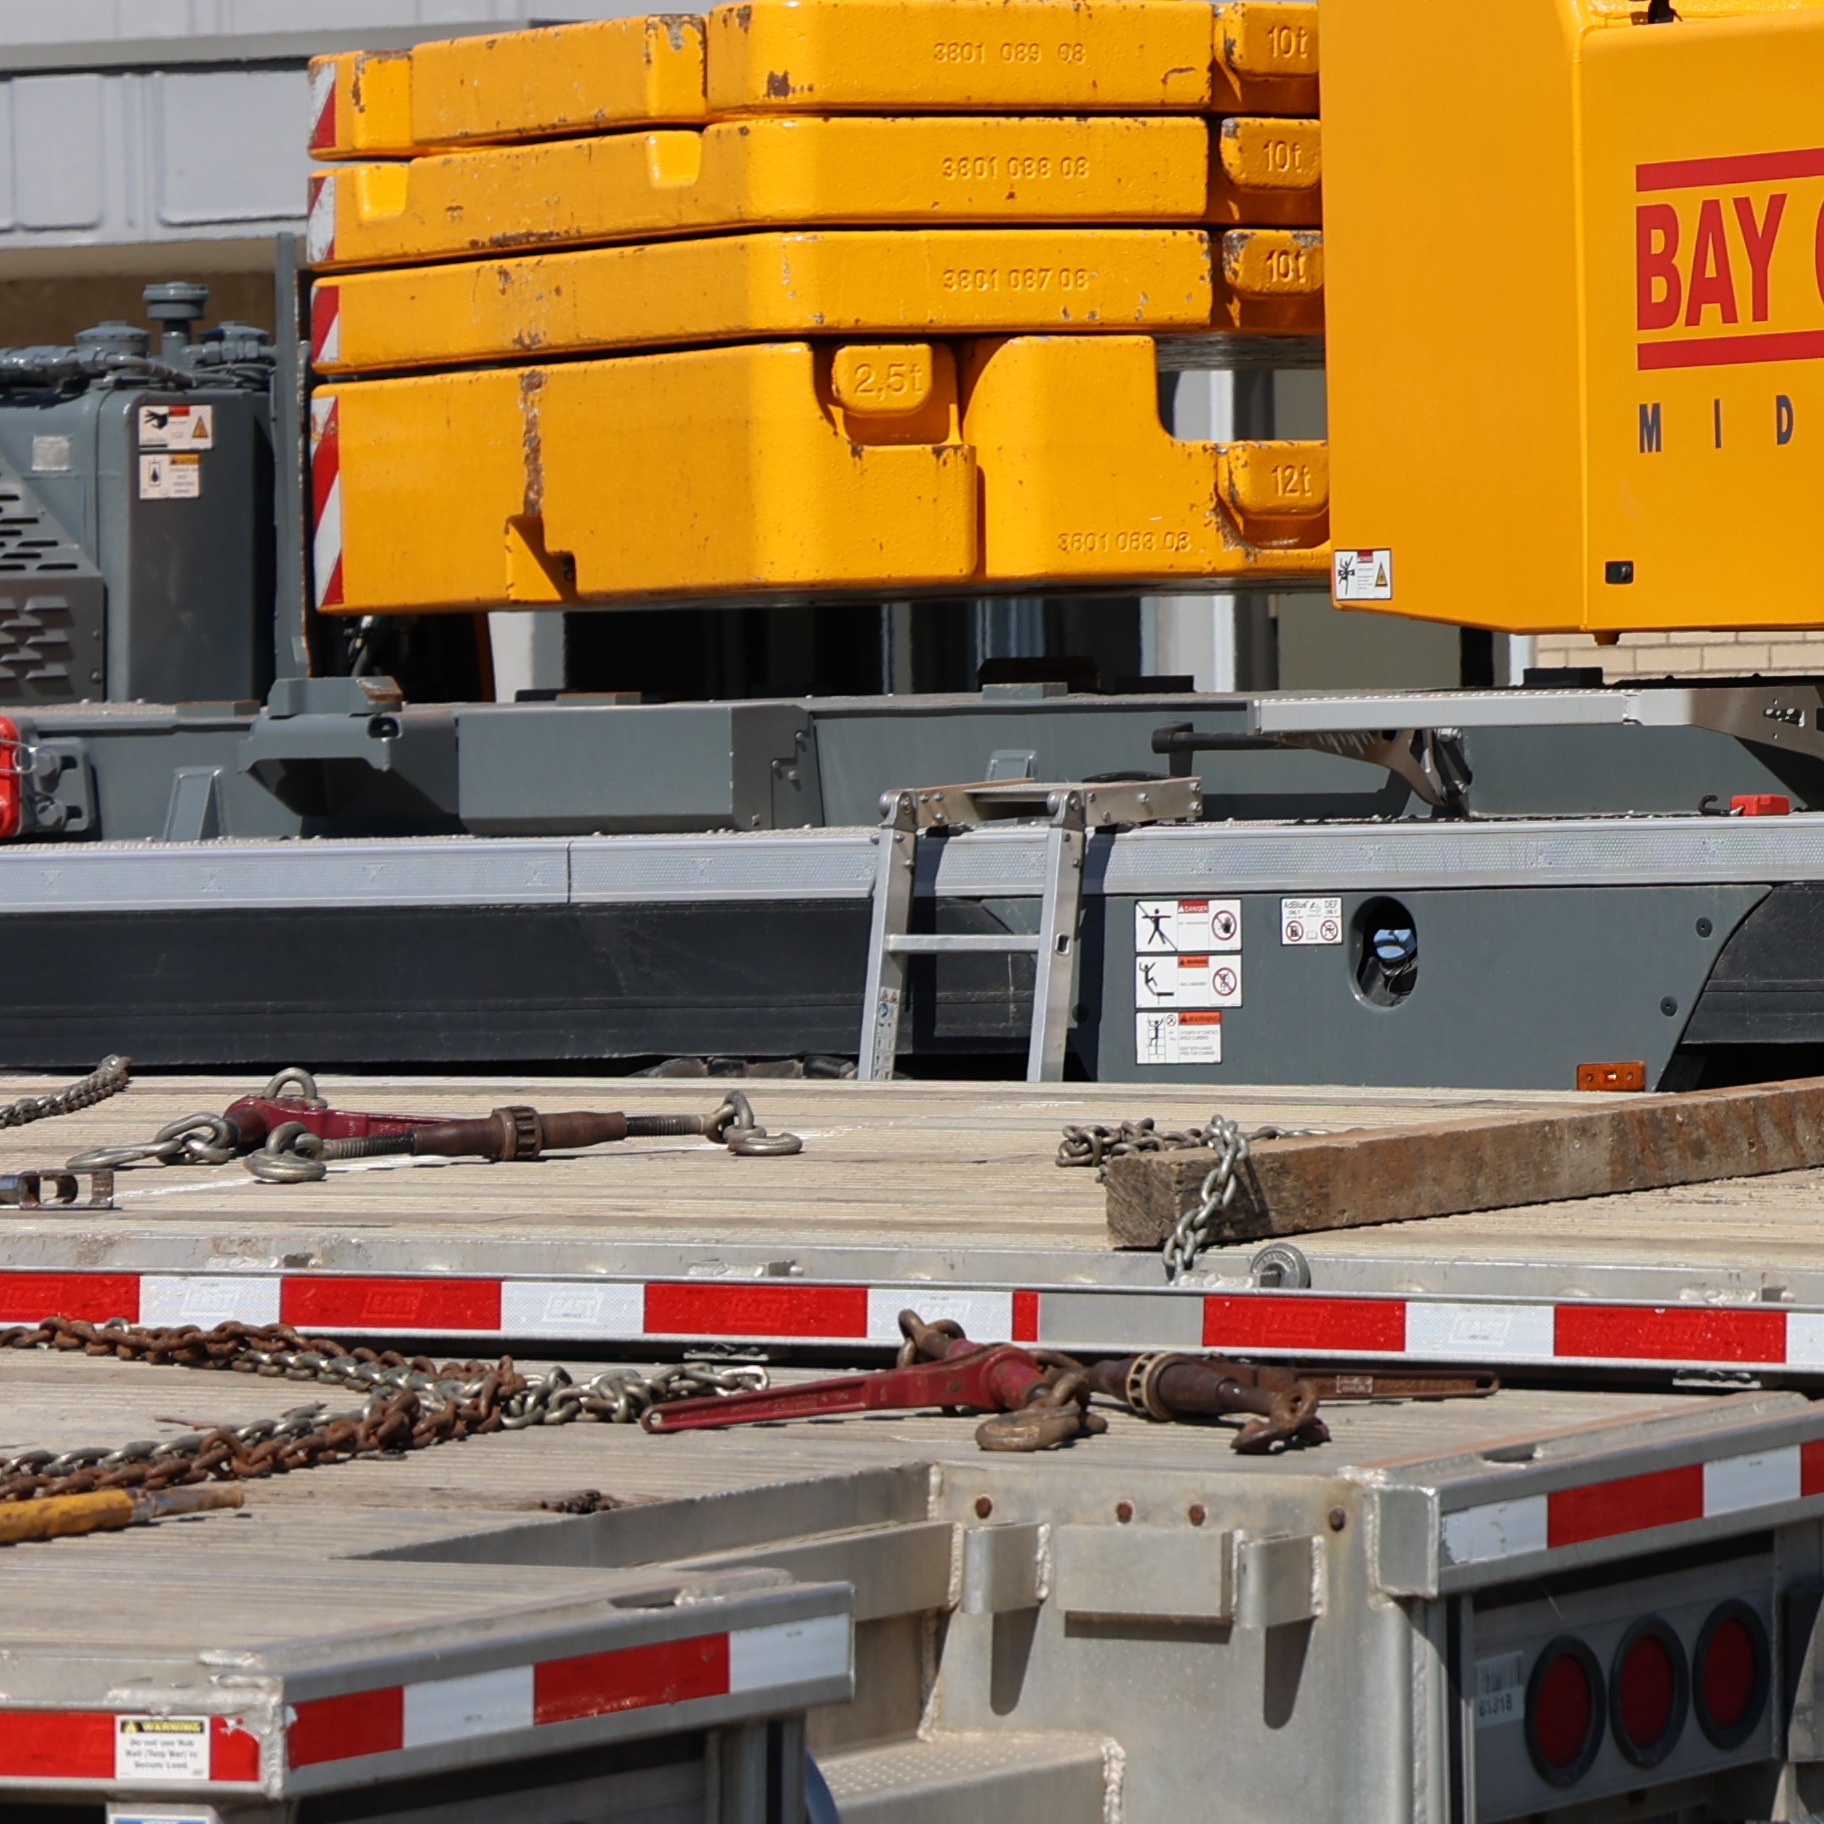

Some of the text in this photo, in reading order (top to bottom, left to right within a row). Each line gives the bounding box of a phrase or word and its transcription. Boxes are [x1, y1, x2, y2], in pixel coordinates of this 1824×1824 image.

[1268, 25, 1309, 58] 10t
[1263, 139, 1302, 173] 10t
[1266, 250, 1307, 283] 10t
[1636, 194, 1787, 332] BAY
[855, 363, 923, 401] 2,5t
[1270, 463, 1312, 497] 12t
[142, 1721, 201, 1732] WARNING
